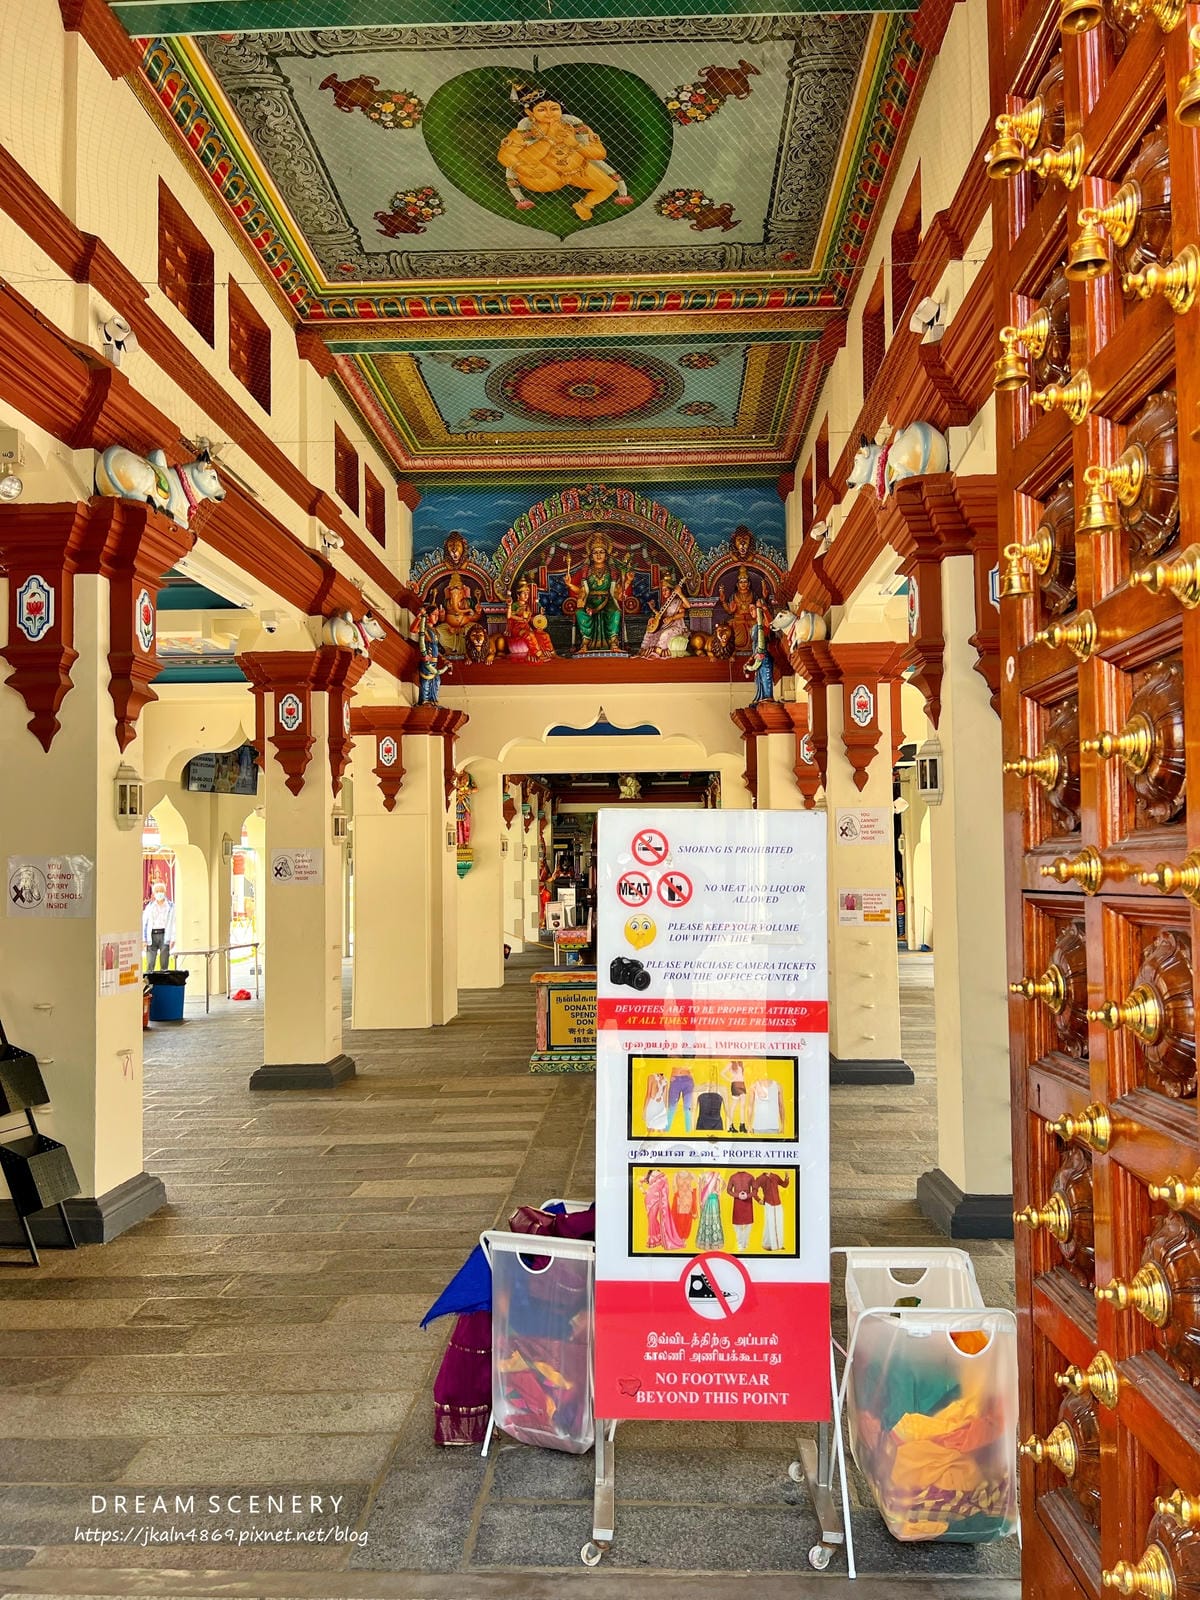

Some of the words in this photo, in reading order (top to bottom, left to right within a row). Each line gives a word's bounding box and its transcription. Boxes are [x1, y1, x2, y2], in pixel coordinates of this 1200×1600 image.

[677, 845, 722, 854] SMOKING
[724, 845, 734, 854] IS
[735, 845, 794, 854] PROHIBITED
[618, 882, 650, 896] MEAT
[704, 884, 719, 893] NO
[720, 884, 746, 893] MEAT
[748, 884, 768, 893] AND
[769, 884, 806, 894] LIQUOR
[47, 892, 60, 900] THE
[732, 895, 779, 904] ALLOWED
[46, 902, 69, 910] INSIDE
[667, 922, 704, 931] PLEASE
[705, 922, 731, 931] KEEP
[732, 923, 757, 931] YOUR
[760, 923, 800, 932] VOLUME
[668, 933, 691, 942] LOW
[691, 934, 727, 942] WITHIN
[730, 934, 749, 943] THE
[646, 960, 682, 969] PLEASE
[683, 960, 734, 970] PURCHASE
[736, 961, 776, 970] CAMERA
[777, 961, 817, 970] TICKETS
[663, 972, 691, 981] FROM
[692, 972, 711, 981] THE
[716, 972, 752, 981] OFFICE
[754, 973, 800, 982] COUNTER
[615, 1004, 665, 1014] DEVOTEES
[667, 1005, 685, 1014] ARE
[687, 1005, 700, 1014] TO
[702, 1005, 715, 1014] BE
[717, 1005, 766, 1015] PROPERLY
[767, 1006, 808, 1015] ATTIRED
[625, 1016, 639, 1025] AT
[640, 1016, 657, 1025] ALL
[659, 1016, 688, 1025] TIMES
[690, 1017, 726, 1026] WITHIN
[727, 1017, 748, 1026] THE
[749, 1018, 797, 1027] PREMISES
[715, 1041, 766, 1050] IMPROPER
[769, 1042, 803, 1051] ATTIRE
[722, 1150, 762, 1158] PROPER
[763, 1150, 800, 1159] ATTIRE
[645, 1331, 732, 1349] இவ்விடத்திற்கு
[734, 1332, 779, 1347] அப்பால்
[643, 1349, 686, 1361] காலணி
[689, 1349, 782, 1365] அணியக்கூடாது
[655, 1372, 678, 1385] NO
[681, 1372, 770, 1386] FOOTWEAR
[635, 1391, 700, 1405] BEYOND
[702, 1391, 740, 1405] THIS
[742, 1392, 790, 1406] POINT
